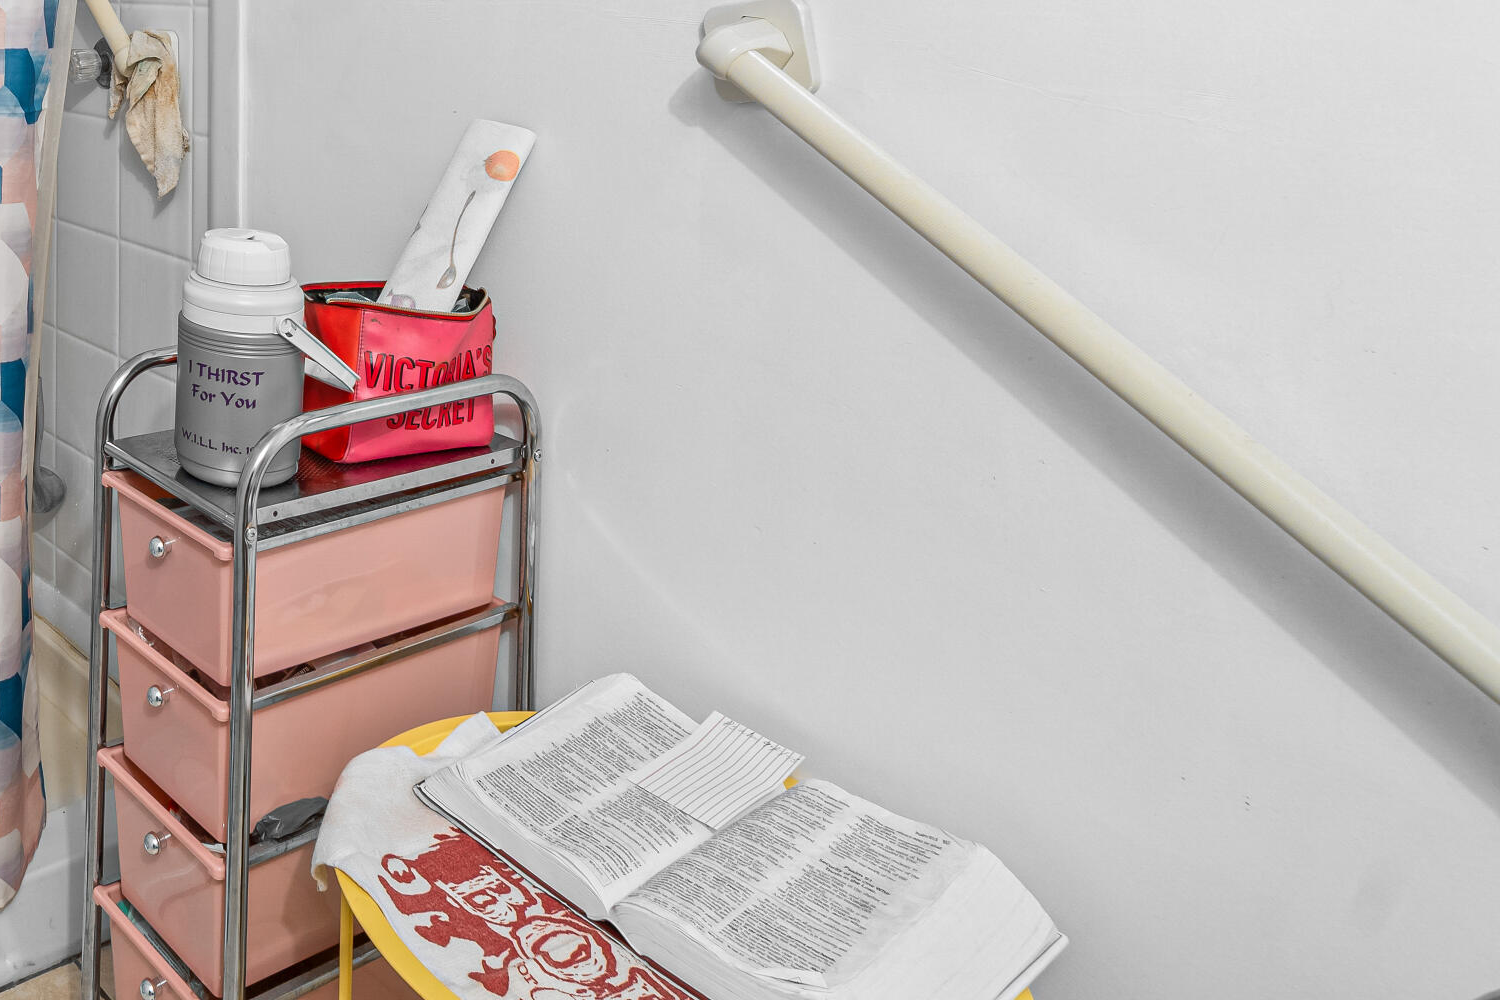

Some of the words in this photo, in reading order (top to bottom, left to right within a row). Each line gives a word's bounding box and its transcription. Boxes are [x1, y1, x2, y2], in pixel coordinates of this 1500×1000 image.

[188, 359, 192, 373] I
[196, 362, 265, 387] THIRST
[364, 345, 492, 392] VICTORIA'S
[191, 383, 216, 403] For
[220, 391, 257, 410] You
[181, 427, 218, 450] W.I.L.L.
[221, 442, 242, 455] Inc.
